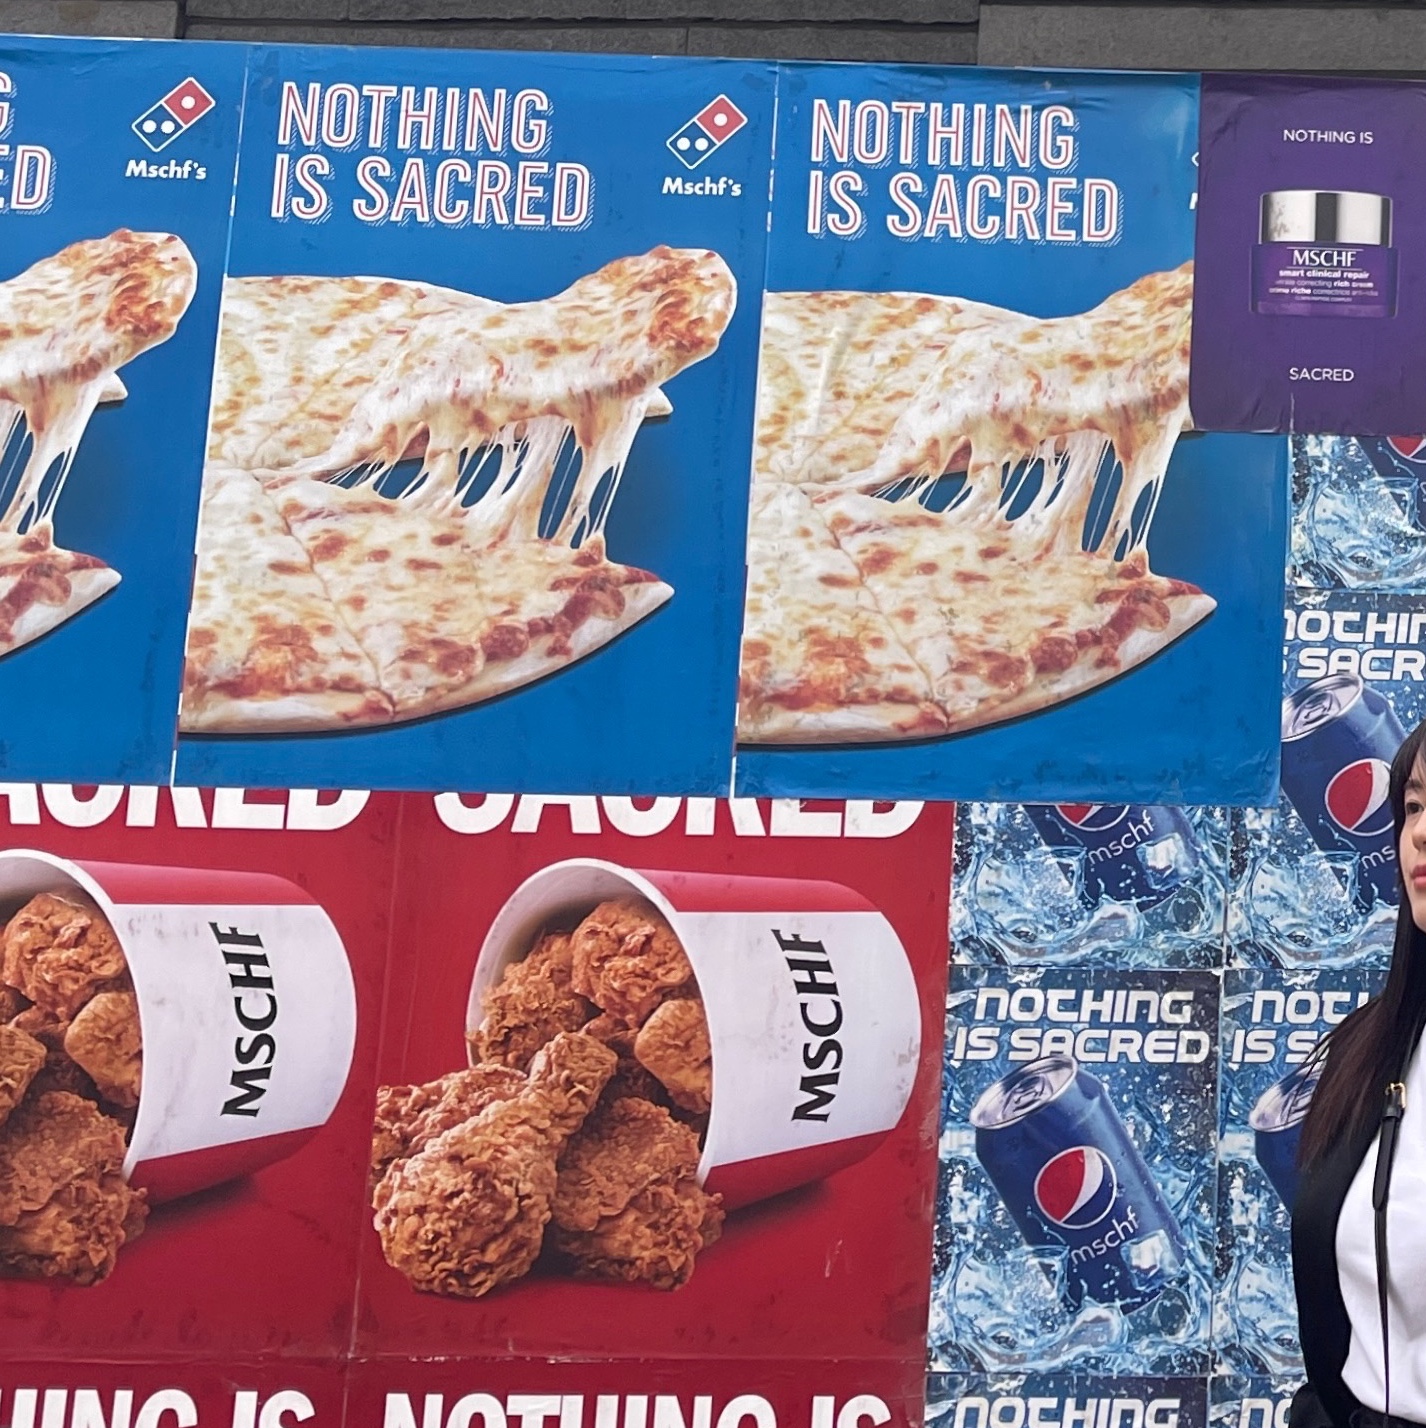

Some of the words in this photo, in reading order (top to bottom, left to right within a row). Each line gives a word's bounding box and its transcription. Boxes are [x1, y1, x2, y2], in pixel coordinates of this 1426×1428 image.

[278, 81, 550, 154] NOTHING
[811, 98, 1077, 169] NOTHING
[1283, 129, 1356, 144] NOTHING
[1359, 132, 1374, 144] IS
[125, 159, 207, 180] Mschf's
[662, 176, 742, 198] Mschf's
[271, 153, 330, 220] IS
[353, 157, 592, 228] SACRED
[807, 170, 863, 235] IS
[887, 172, 1121, 243] SACRED
[1279, 270, 1305, 278] smart
[1306, 270, 1342, 278] clinical
[1343, 272, 1370, 280] repair
[1293, 249, 1357, 267] MSCHF
[1333, 280, 1350, 288] rich
[1289, 367, 1355, 382] SACRED
[1089, 811, 1155, 866] mschf
[208, 921, 279, 1118] MSCHF
[771, 928, 845, 1123] MSCHF
[952, 1027, 999, 1062] IS
[1007, 1028, 1211, 1064] SACRED
[1232, 1029, 1277, 1063] IS
[1071, 1205, 1140, 1266] mschf
